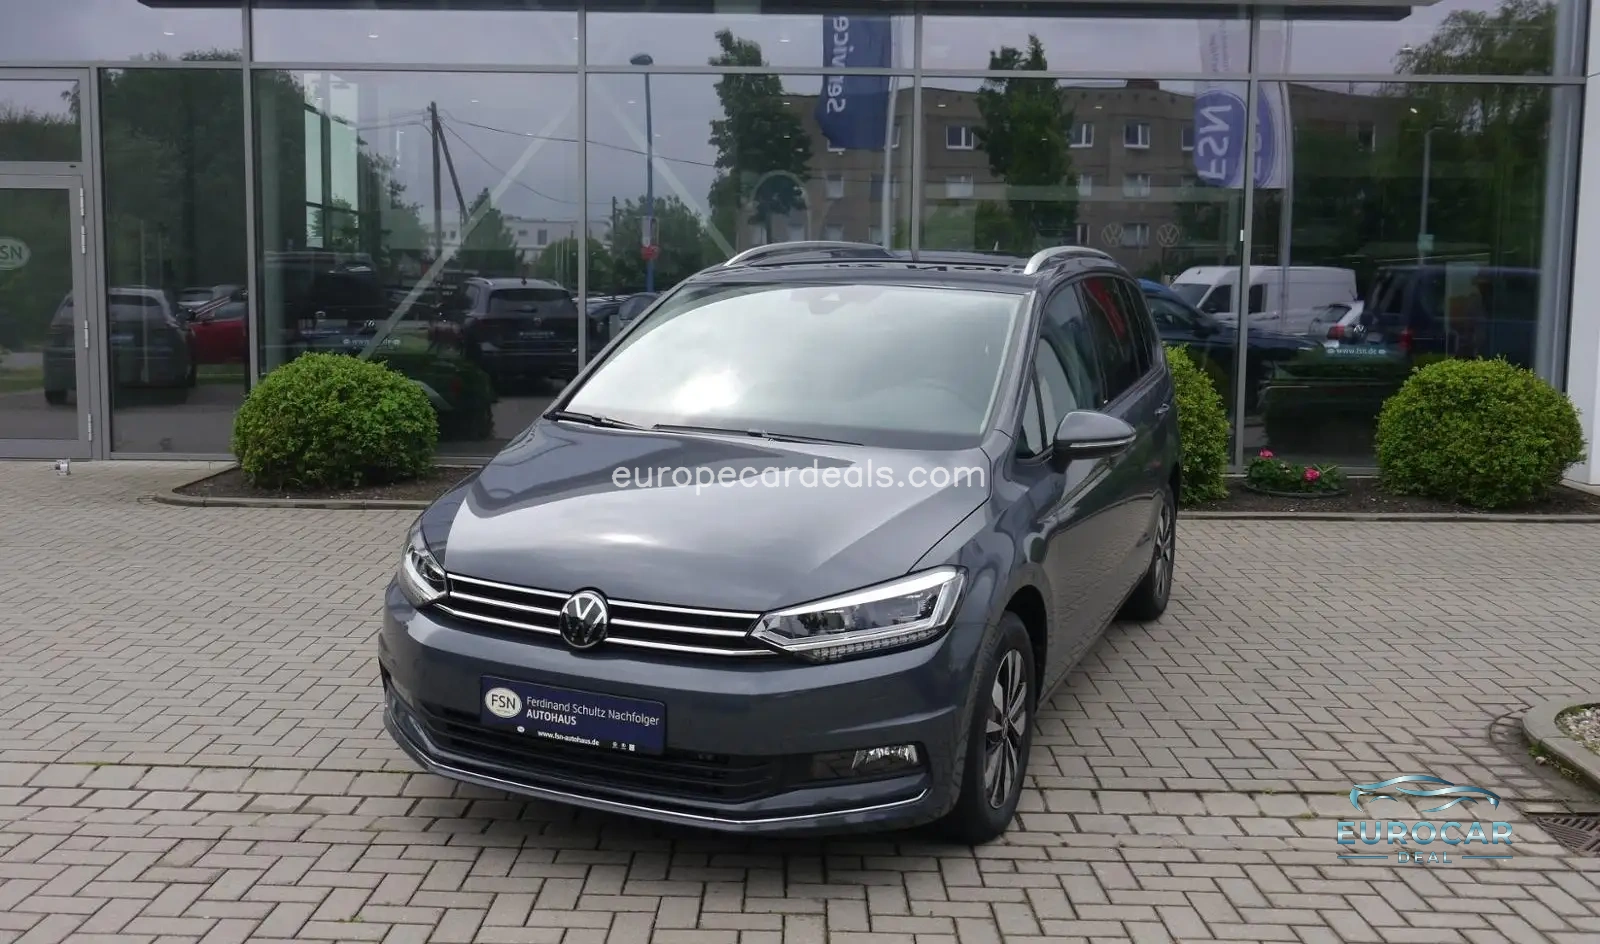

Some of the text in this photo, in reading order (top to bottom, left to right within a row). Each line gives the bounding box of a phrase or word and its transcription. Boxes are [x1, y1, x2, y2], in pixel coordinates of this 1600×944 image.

[0, 245, 22, 259] SN
[491, 693, 516, 710] FSN
[526, 696, 660, 727] Ferdinand Schultz Nachfolger
[526, 708, 577, 726] AUTOHAUS
[537, 730, 600, 747] www.fsn-autohaus.de
